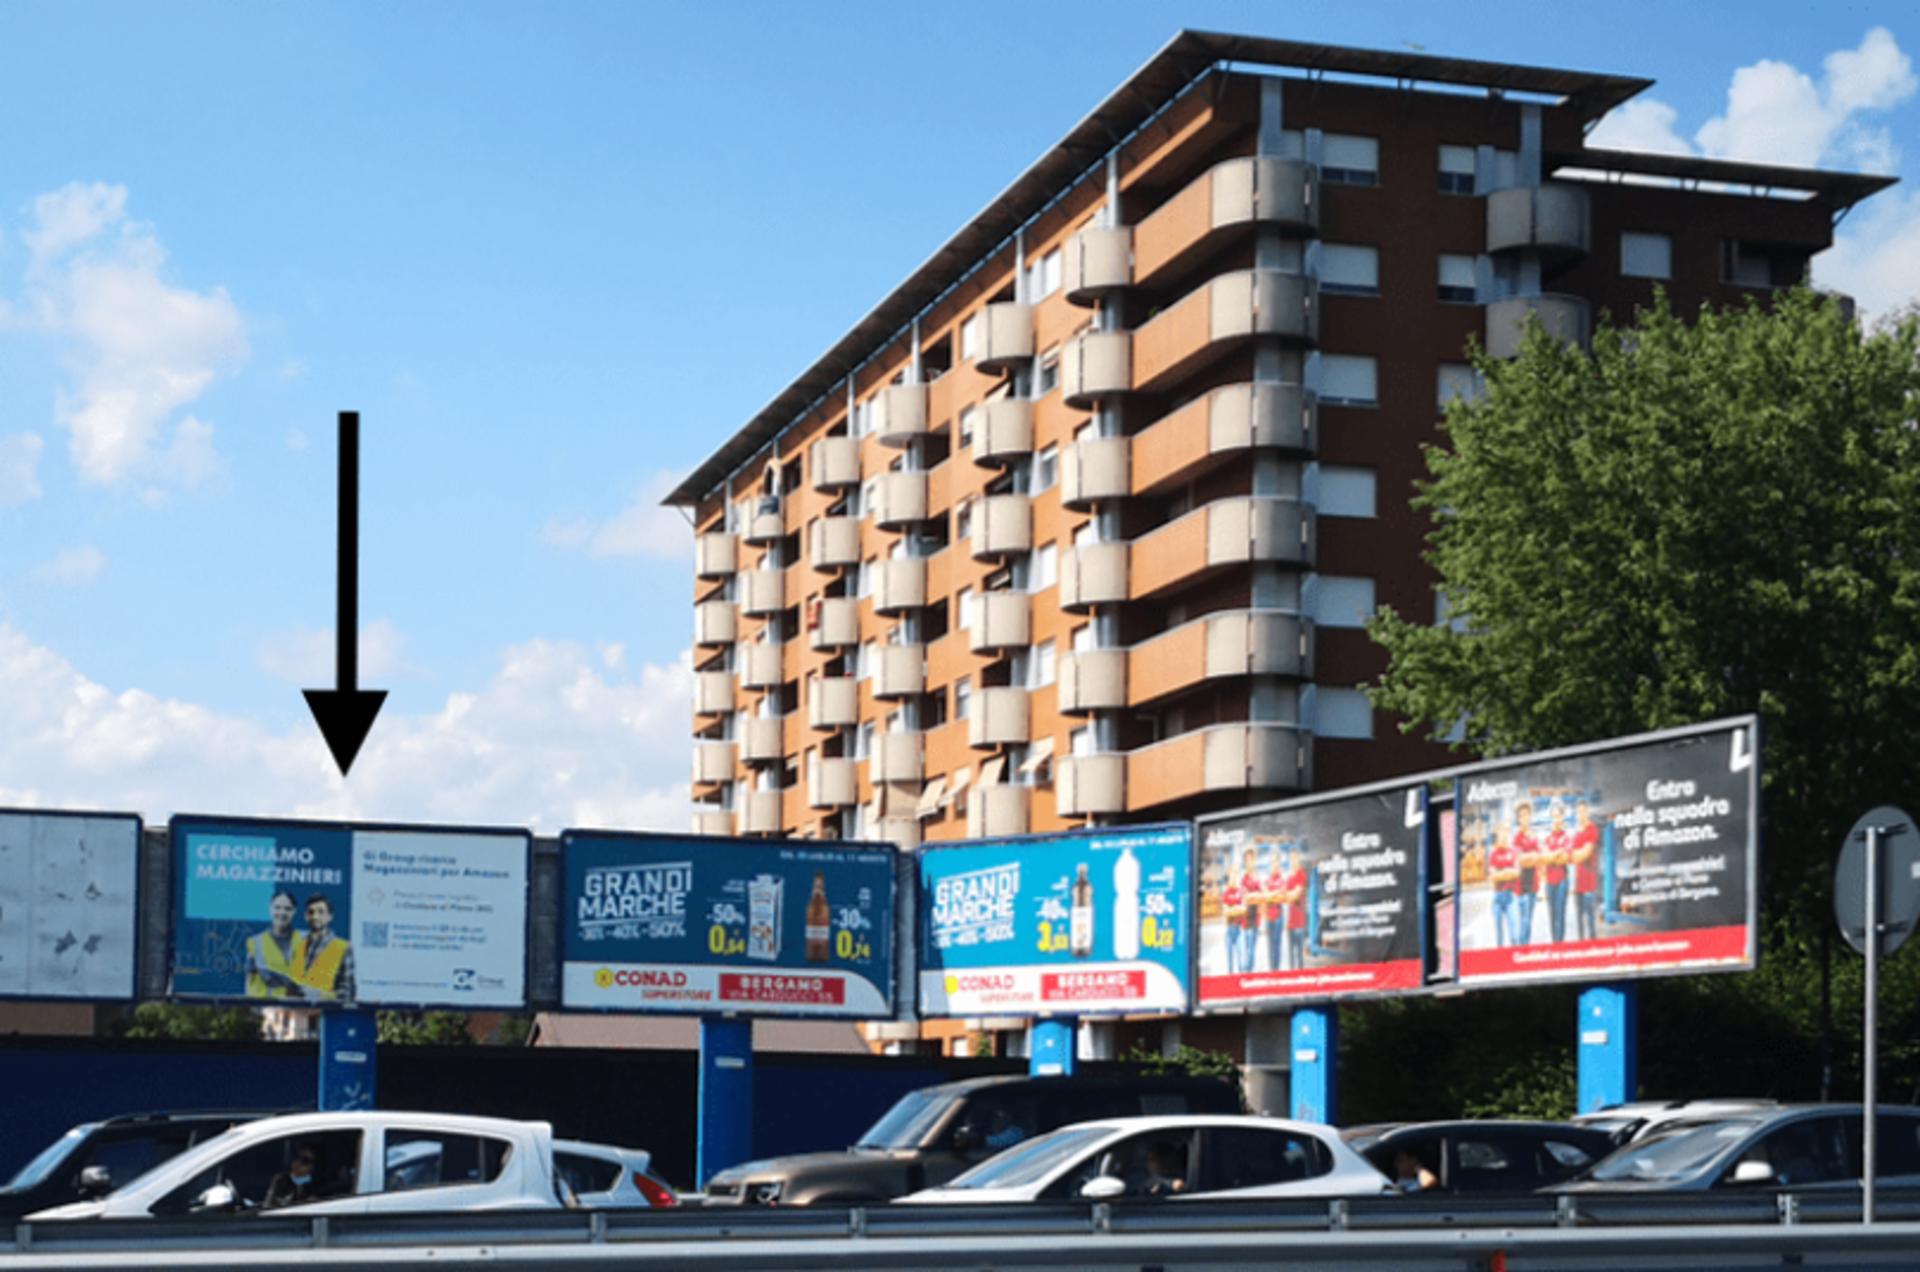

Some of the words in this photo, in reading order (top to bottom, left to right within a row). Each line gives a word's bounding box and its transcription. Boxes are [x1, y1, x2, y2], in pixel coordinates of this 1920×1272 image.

[1658, 795, 1730, 827] squadra
[1623, 827, 1640, 849] di
[1644, 824, 1719, 847] Amazon.
[196, 844, 314, 864] CERCHIAMO
[195, 863, 342, 884] MAGAZZINIERI
[585, 869, 692, 896] GRANDI
[936, 872, 1019, 905] GRANDI
[579, 893, 686, 919] MARCHE
[932, 894, 1014, 928] MARCHE
[615, 970, 687, 987] CONAD
[741, 977, 823, 992] BERGAMO
[959, 975, 1014, 991] CONAD
